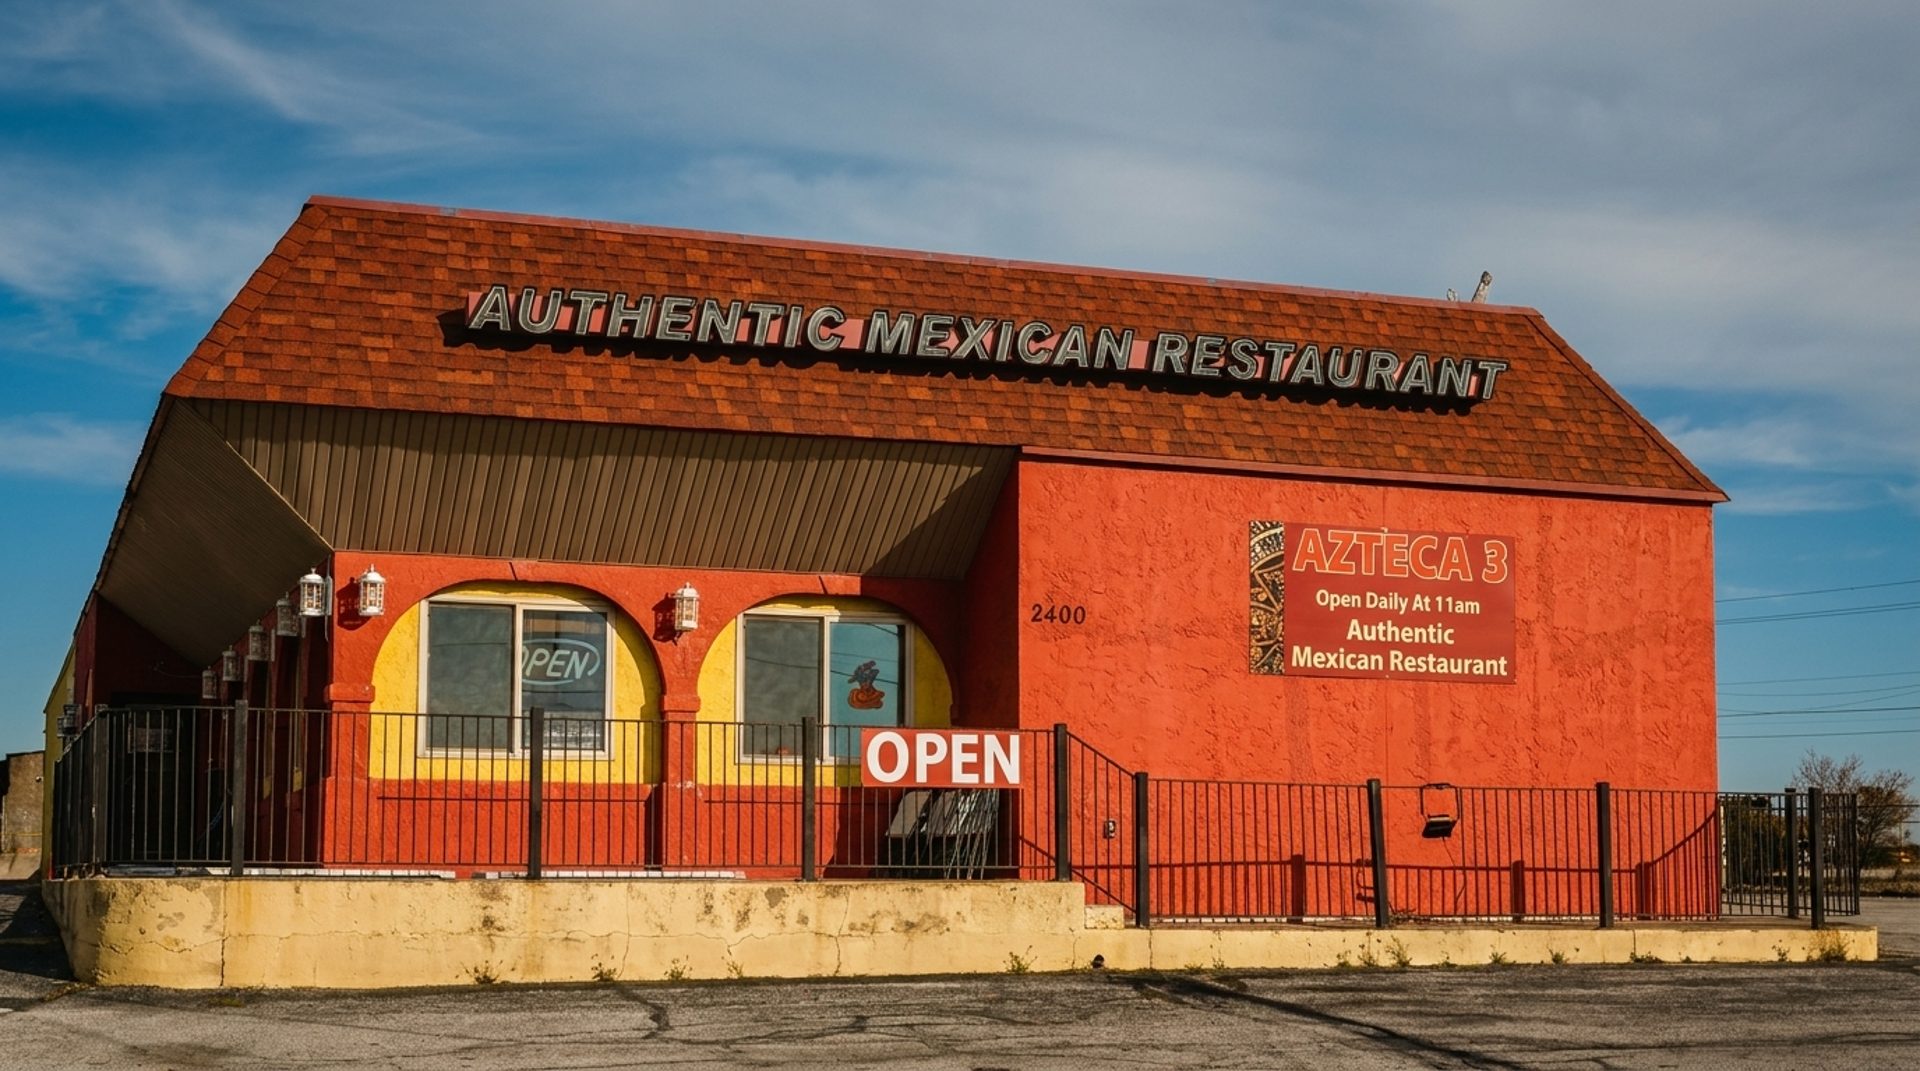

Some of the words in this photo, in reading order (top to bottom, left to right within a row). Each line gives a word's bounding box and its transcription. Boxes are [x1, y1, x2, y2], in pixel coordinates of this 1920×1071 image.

[468, 285, 846, 352] AUTHENTIC
[865, 309, 1135, 372] MEXICAN
[1155, 331, 1507, 400] RESTAURANT
[1292, 528, 1473, 582] AZTECA
[1481, 540, 1508, 584] 3
[1031, 604, 1086, 624] 2400
[1315, 589, 1362, 611] Open
[1366, 592, 1408, 614] Daily
[1412, 594, 1431, 612] At
[1435, 596, 1480, 614] 11am
[1346, 619, 1455, 645] Authentic
[1291, 646, 1384, 671] Mexican
[1390, 650, 1508, 676] Restaurant
[866, 731, 1021, 785] OPEN
